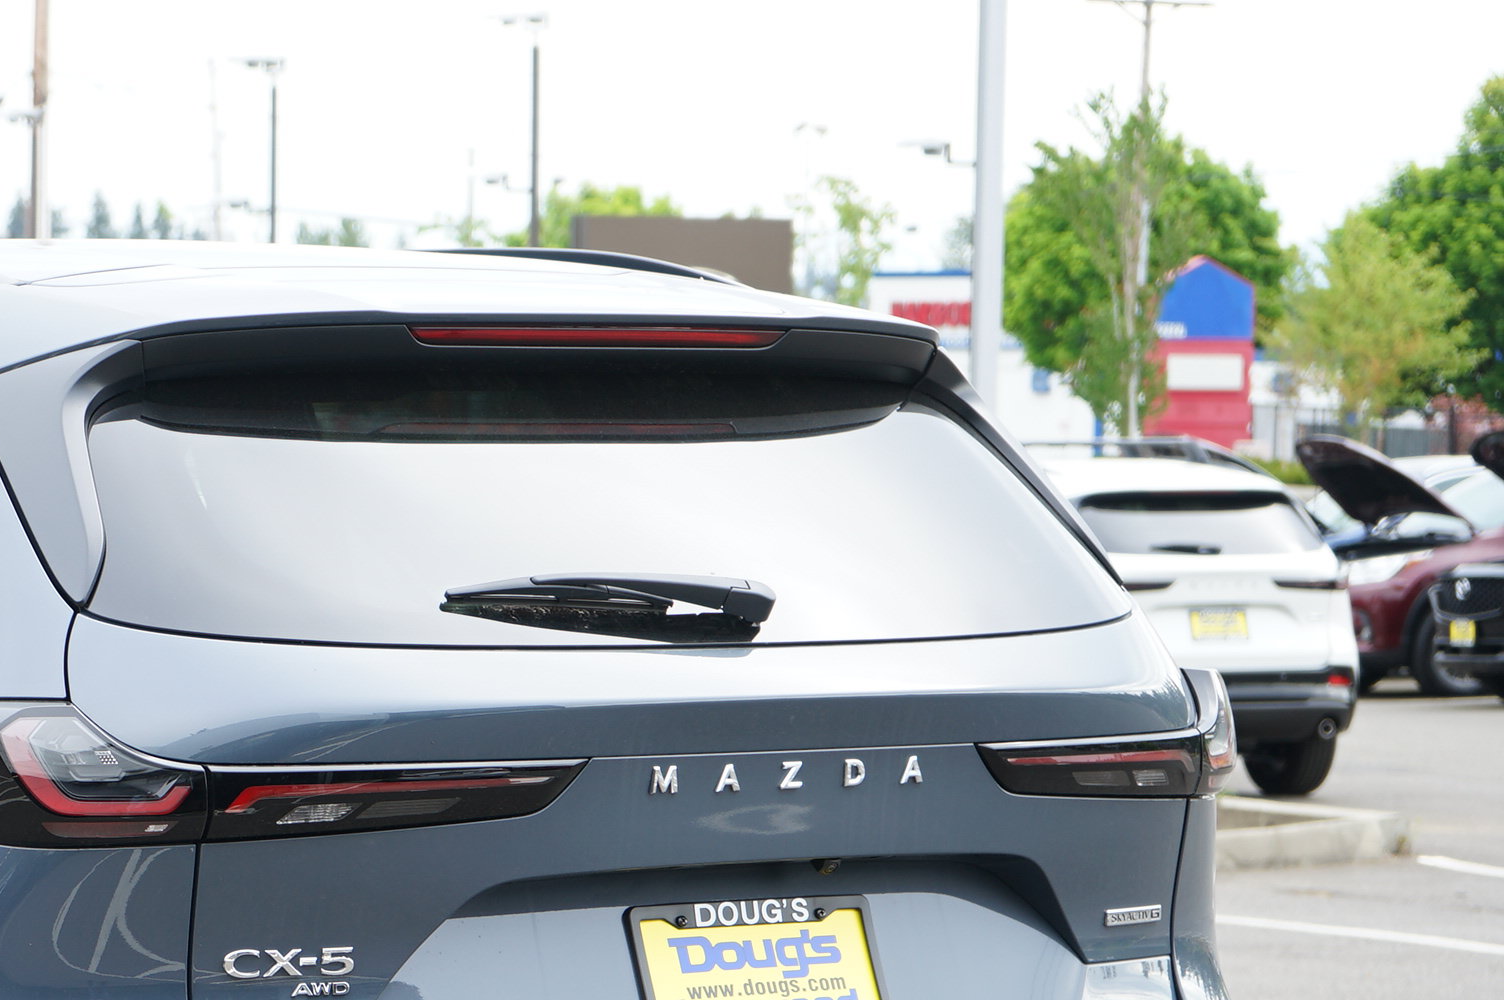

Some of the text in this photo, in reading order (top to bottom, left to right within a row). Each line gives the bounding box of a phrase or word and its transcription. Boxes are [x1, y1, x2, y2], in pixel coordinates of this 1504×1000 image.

[650, 755, 924, 794] MAZDA
[694, 897, 810, 927] DOUG'S
[223, 946, 355, 979] CX-5
[291, 981, 350, 997] AWD
[686, 976, 847, 1000] www.dougs.com
